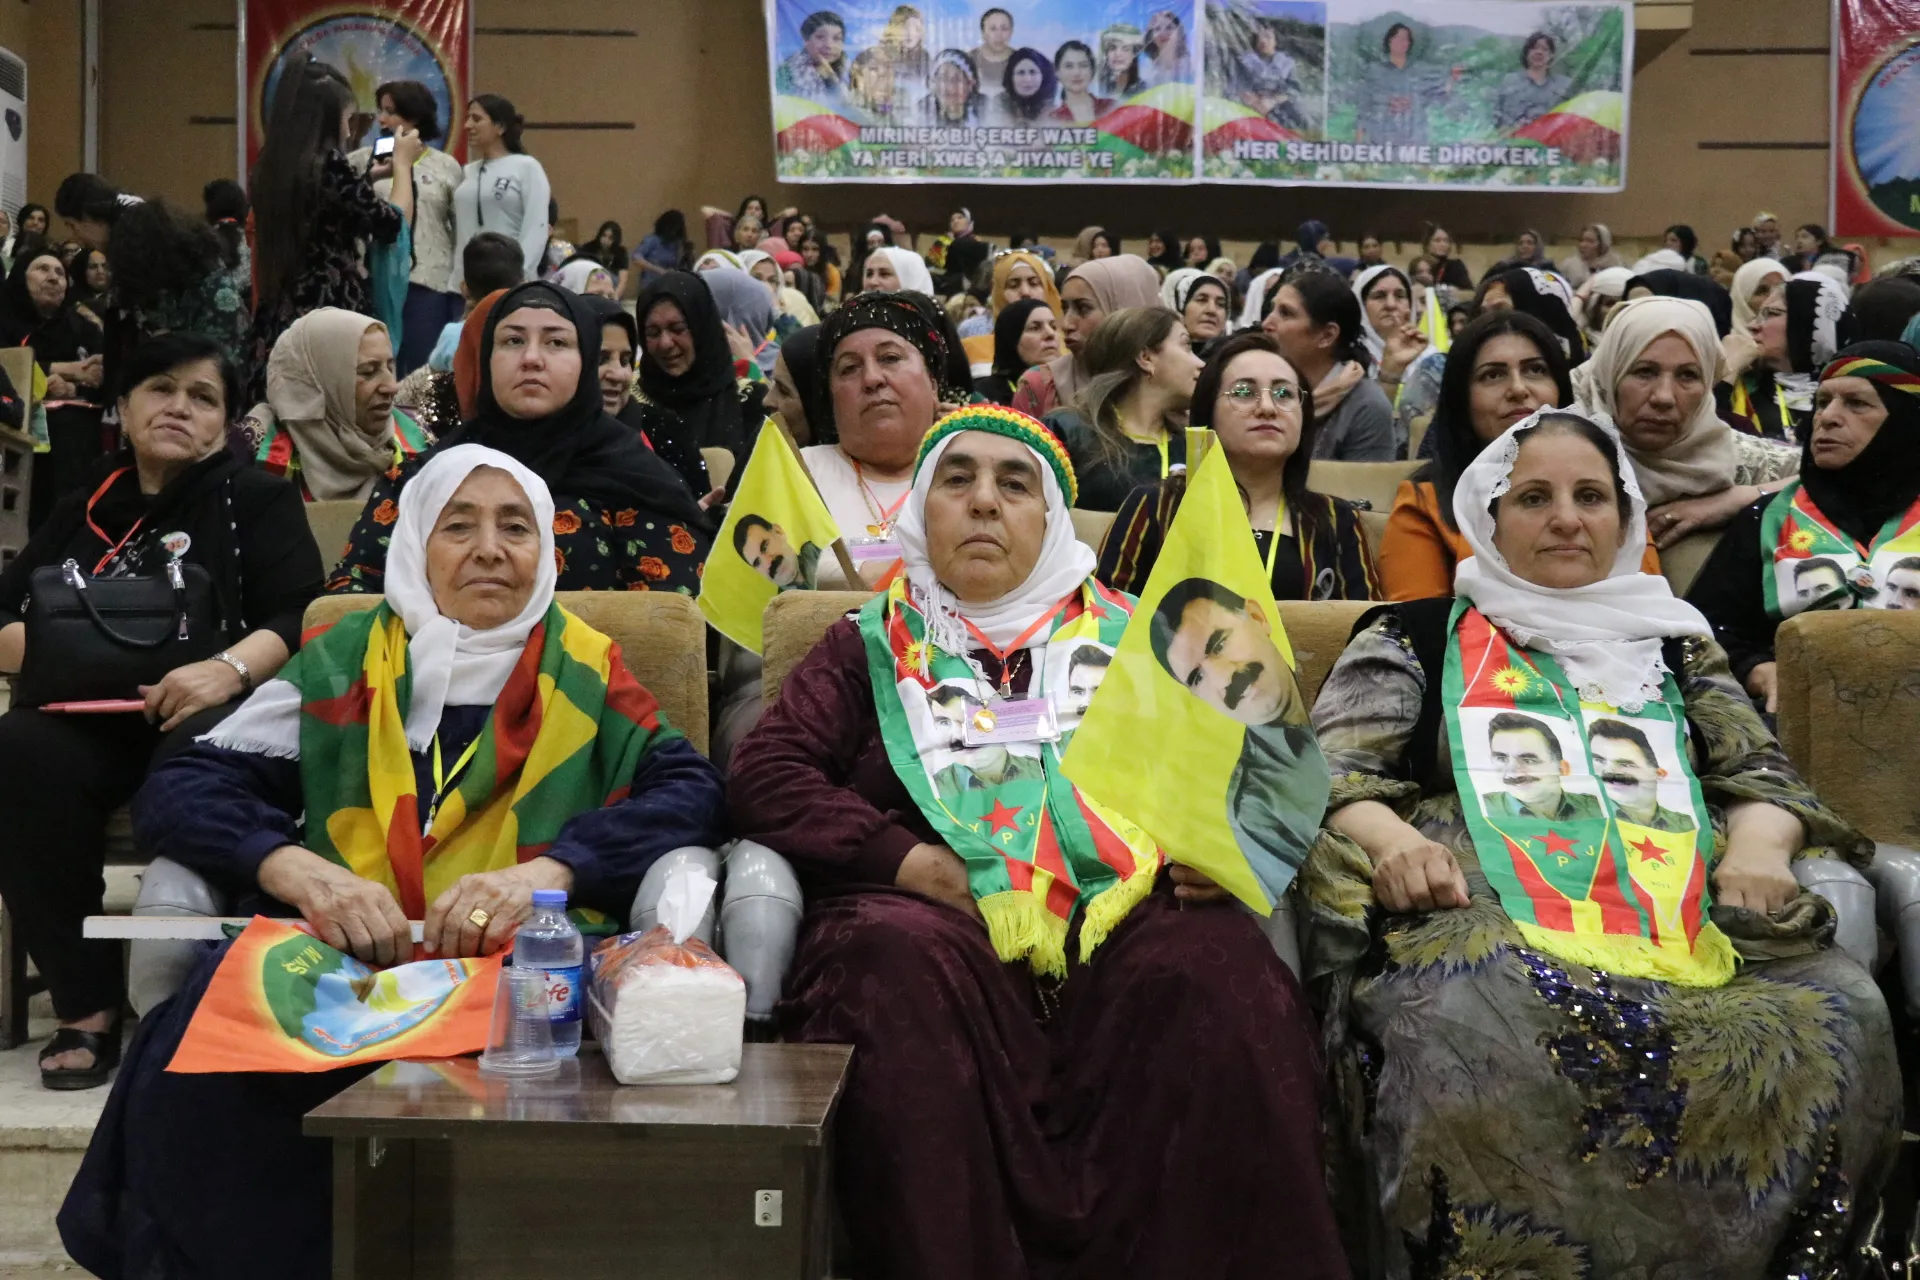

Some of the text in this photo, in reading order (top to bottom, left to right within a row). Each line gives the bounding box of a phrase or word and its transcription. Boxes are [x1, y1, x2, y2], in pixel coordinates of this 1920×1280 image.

[1043, 127, 1097, 145] WATE
[851, 150, 875, 167] YA
[1087, 151, 1113, 168] YE
[1234, 140, 1280, 160] HER
[1398, 144, 1432, 164] ME
[1001, 831, 1014, 845] P
[1557, 855, 1570, 868] P
